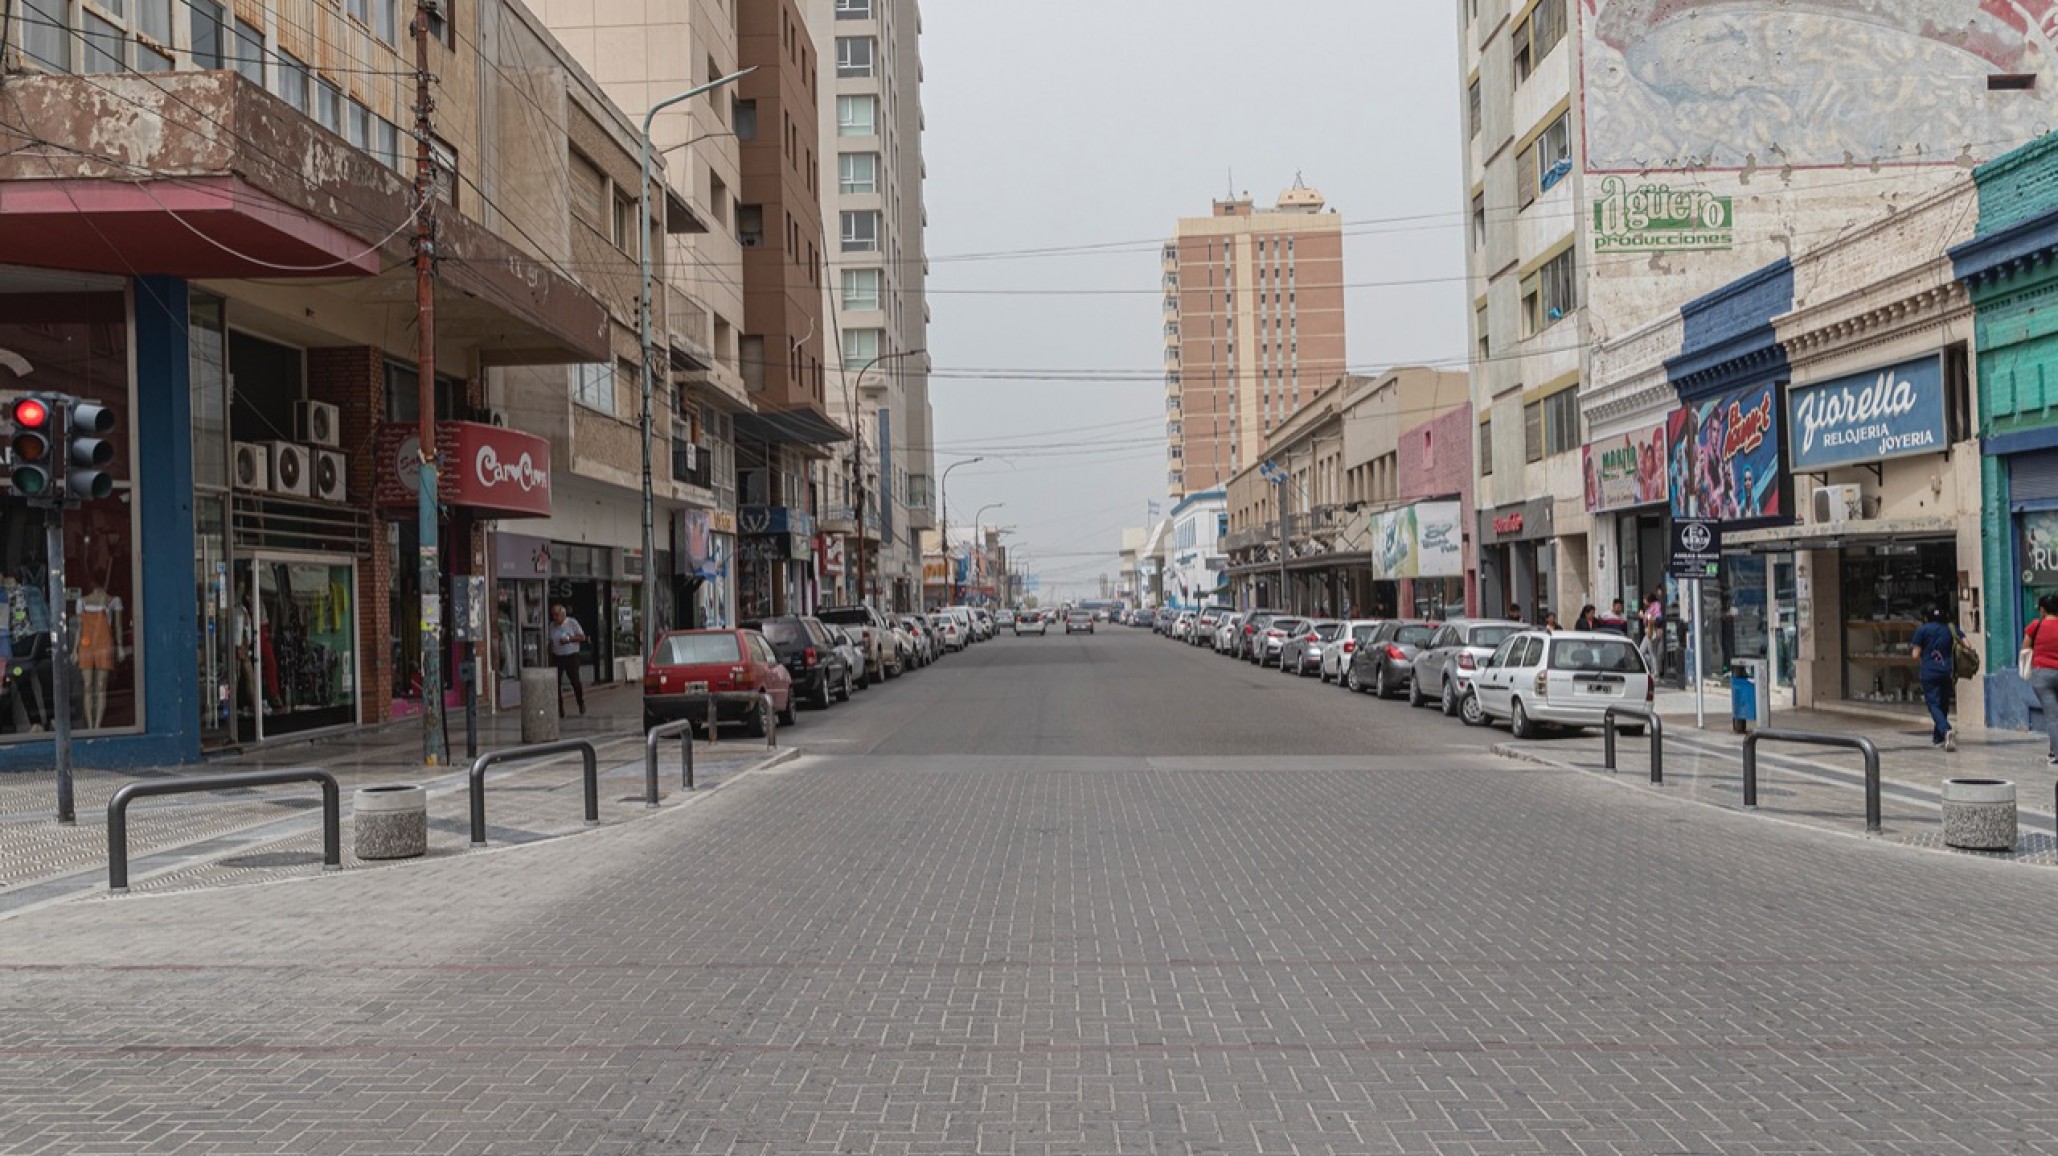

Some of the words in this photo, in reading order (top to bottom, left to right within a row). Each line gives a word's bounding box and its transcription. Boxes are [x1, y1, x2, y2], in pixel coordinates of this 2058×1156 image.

[1602, 176, 1725, 236] Agüero
[1595, 233, 1733, 249] producciones
[1798, 370, 1917, 454] Fiorella
[1824, 423, 1890, 447] RELOJERIA
[1879, 430, 1934, 454] JOYERIA
